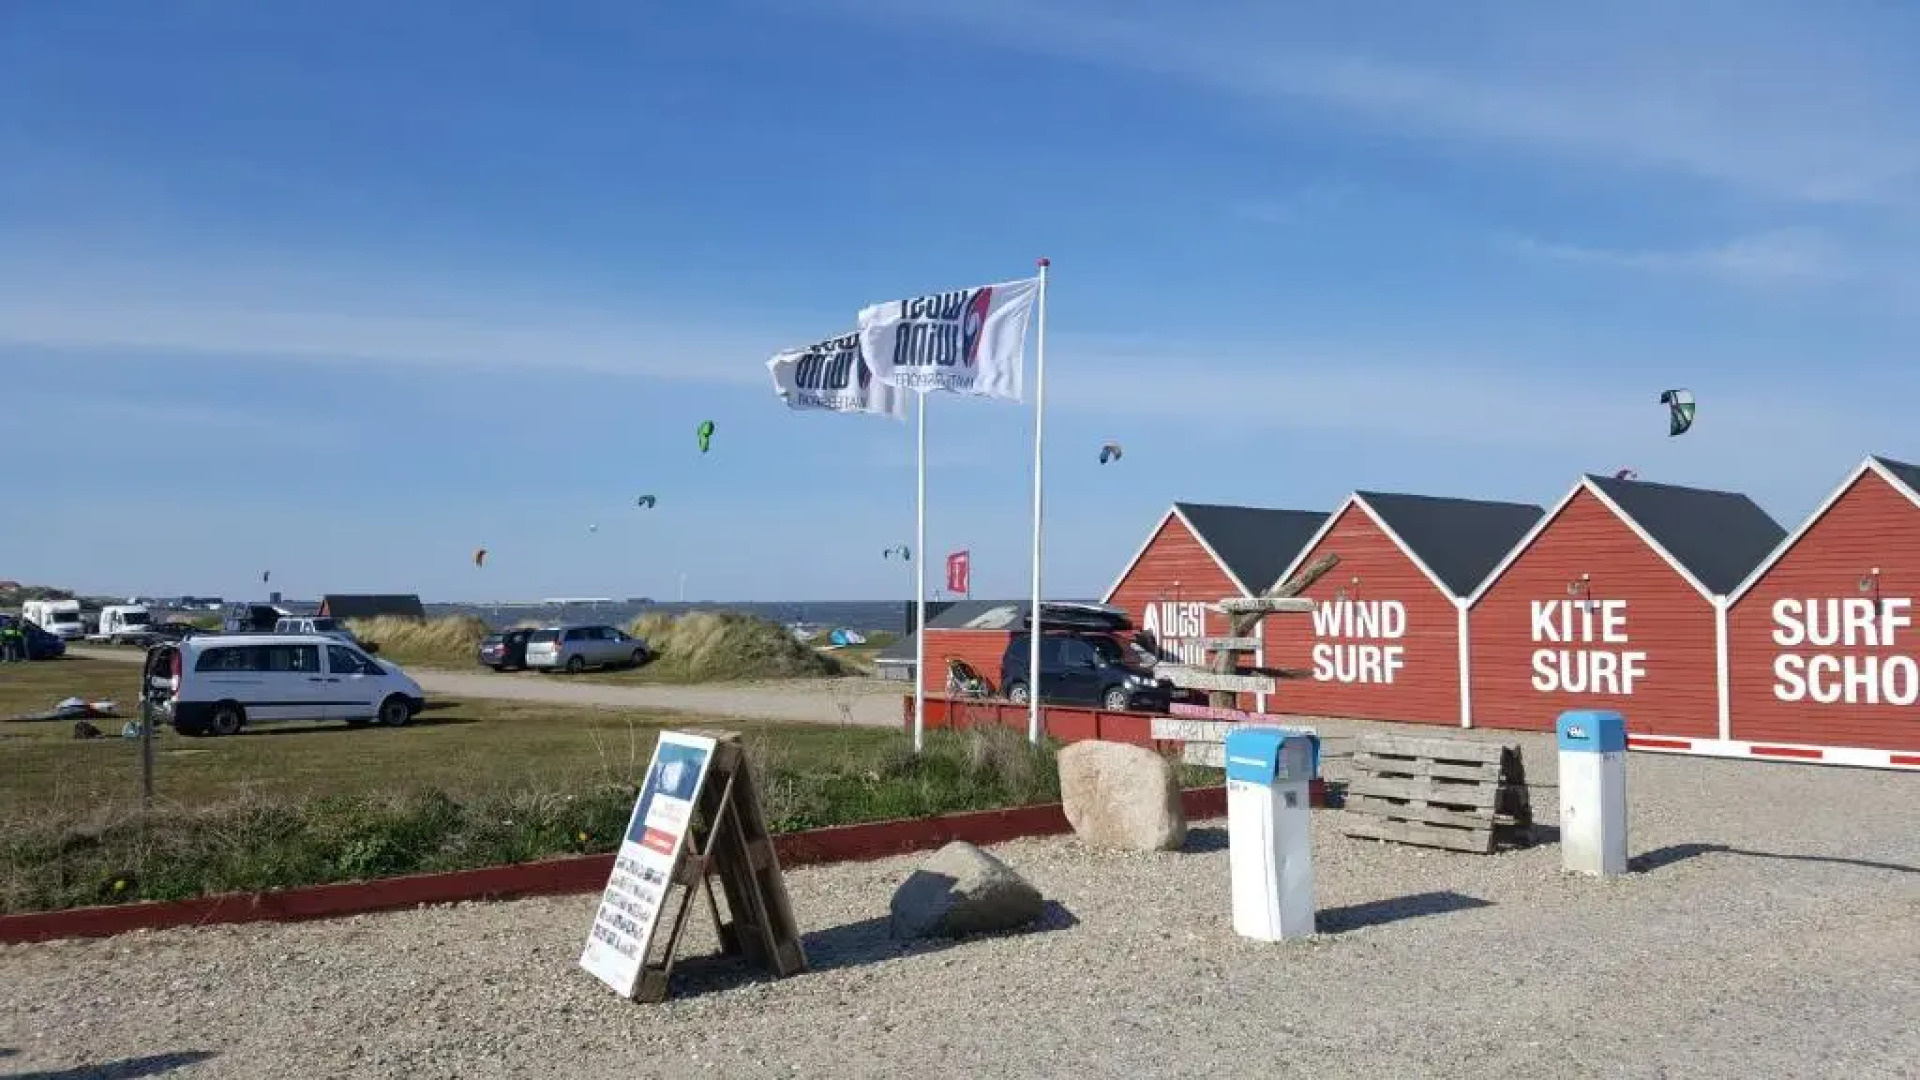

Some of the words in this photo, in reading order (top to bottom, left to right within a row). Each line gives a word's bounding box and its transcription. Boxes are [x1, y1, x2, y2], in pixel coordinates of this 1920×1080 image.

[1312, 600, 1406, 639] WIND
[1531, 599, 1628, 643] KITE
[1772, 597, 1911, 647] SURF
[1312, 644, 1405, 684] SURF
[1531, 649, 1647, 695] SURF
[1773, 654, 1920, 706] SCHO
